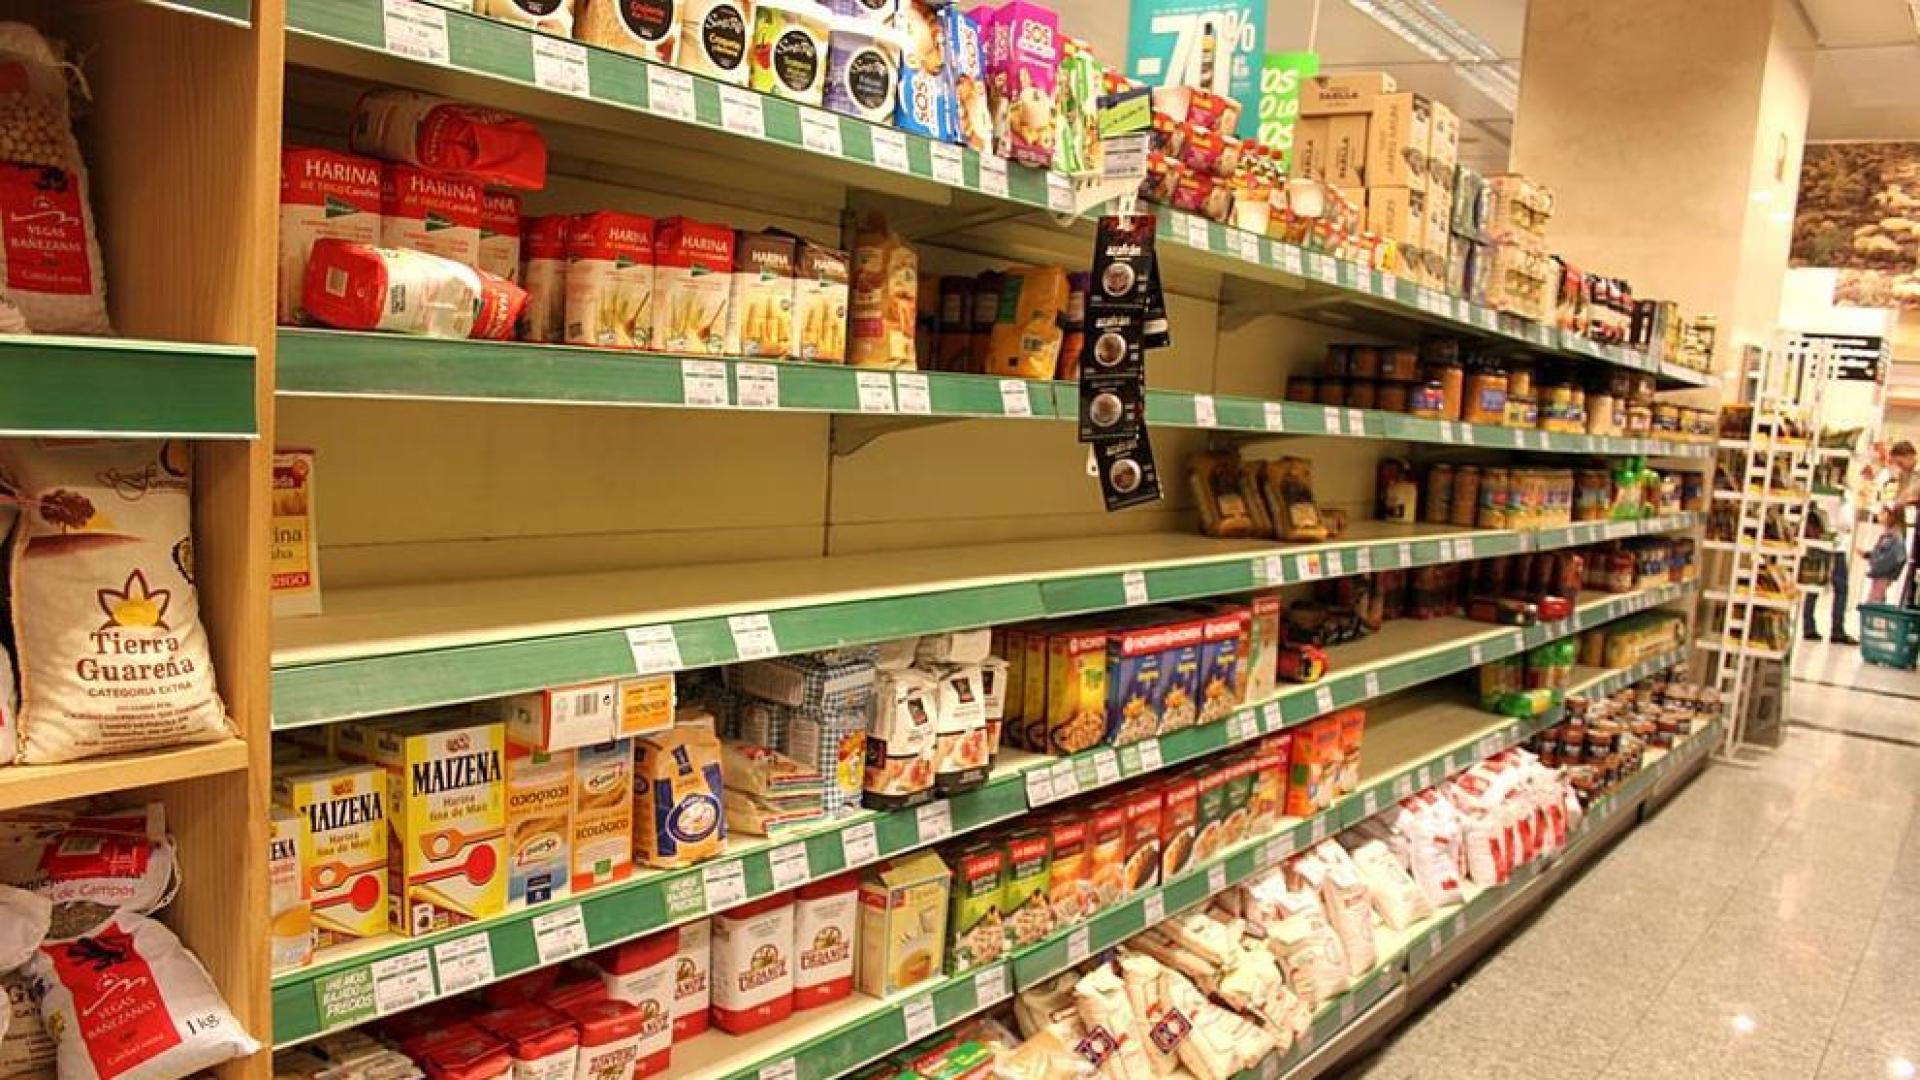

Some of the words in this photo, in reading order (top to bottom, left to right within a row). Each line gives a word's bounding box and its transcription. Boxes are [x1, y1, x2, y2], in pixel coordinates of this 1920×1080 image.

[305, 158, 379, 187] HARINA
[410, 174, 477, 202] HARINA
[608, 226, 650, 246] HARINA
[681, 234, 728, 254] HARINA
[751, 249, 789, 267] HARINA
[89, 631, 180, 655] Tierra
[76, 656, 195, 682] Guareña
[411, 750, 502, 798] MAIZENA
[79, 883, 137, 899] Campos
[186, 1019, 197, 1036] 1
